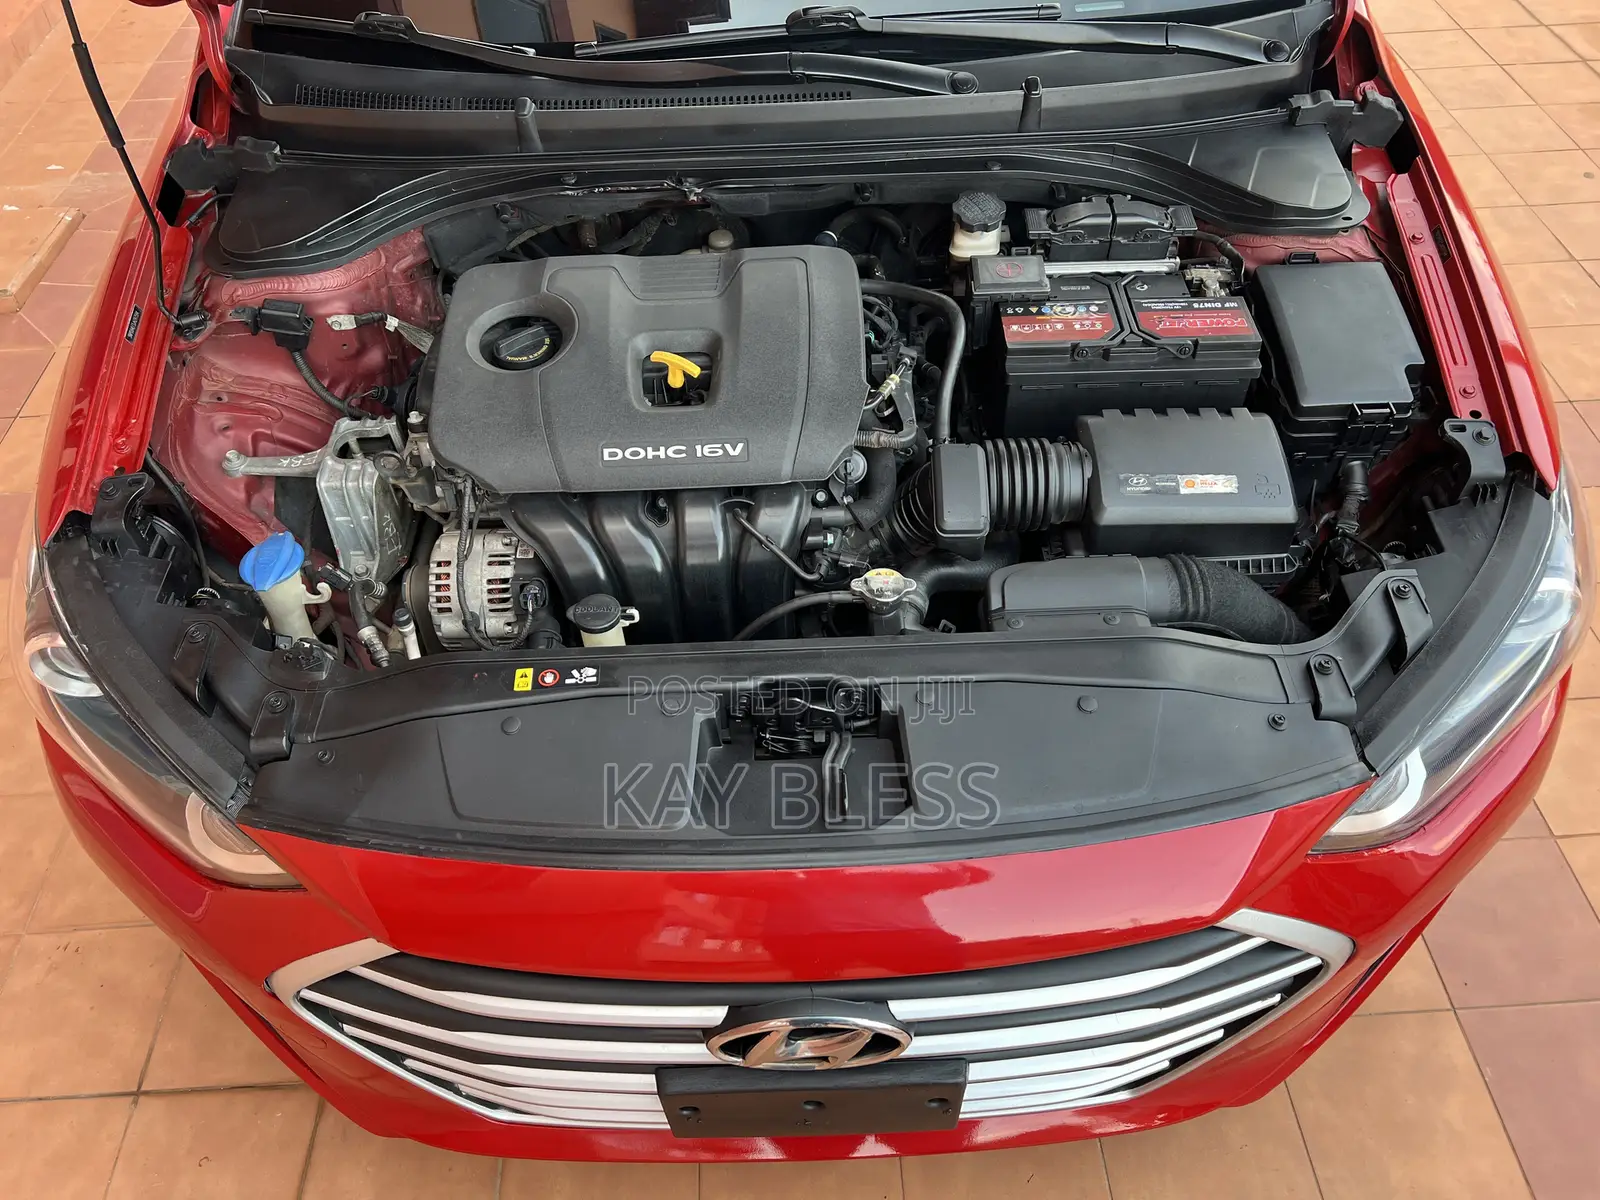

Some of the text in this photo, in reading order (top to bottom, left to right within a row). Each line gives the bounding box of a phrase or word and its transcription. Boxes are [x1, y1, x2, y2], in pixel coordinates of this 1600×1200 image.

[602, 442, 745, 461] DOHC 16V
[574, 605, 618, 614] COOLANT
